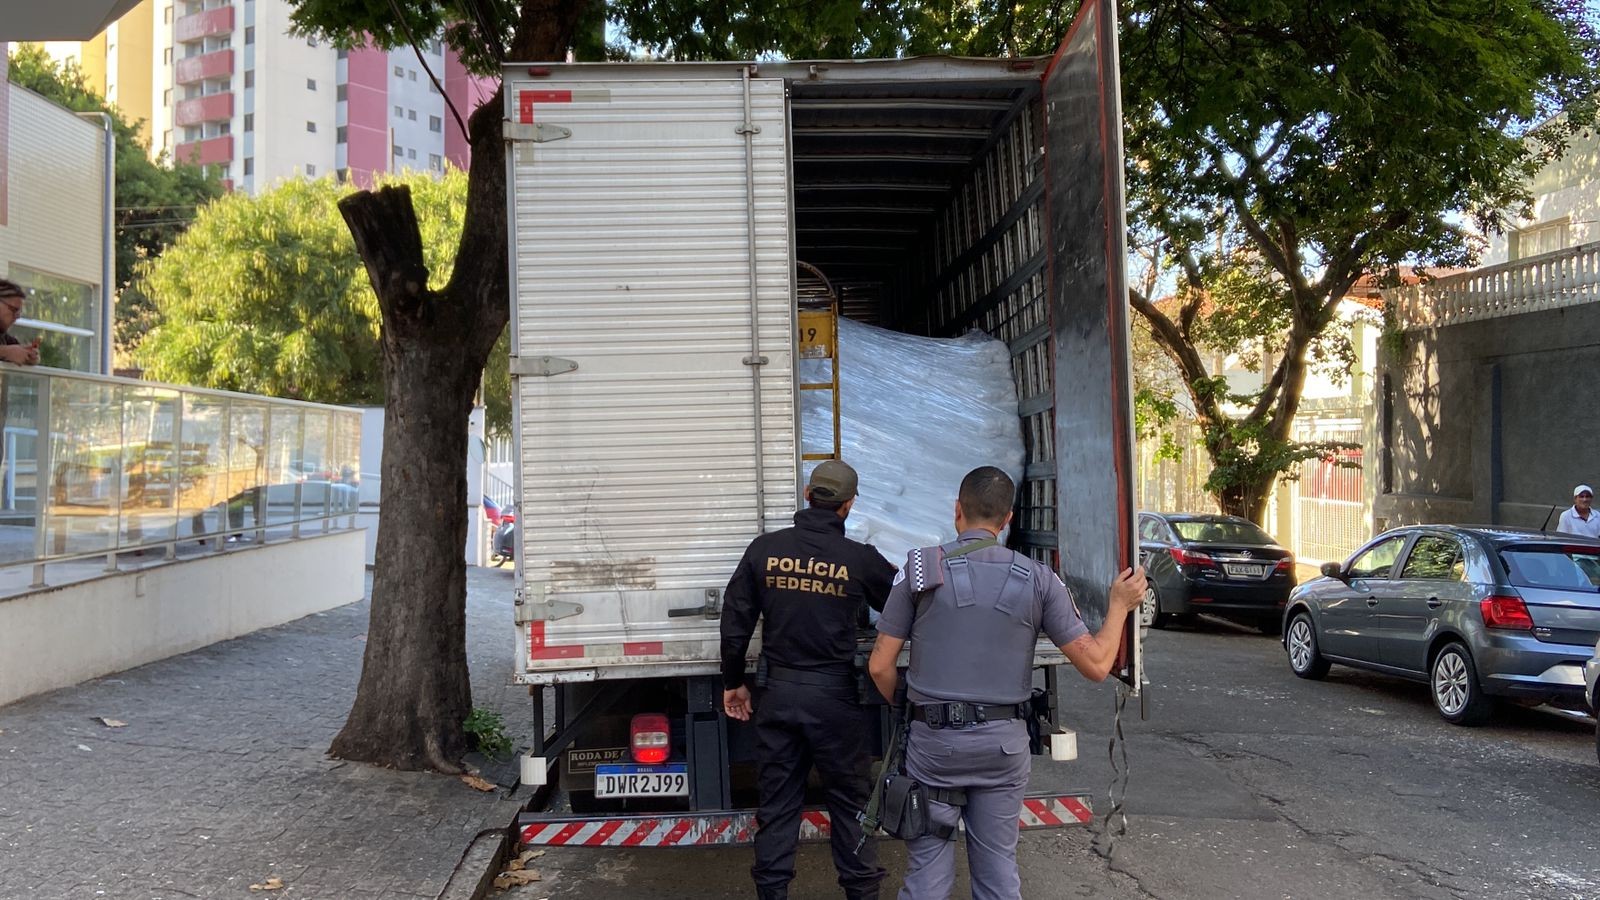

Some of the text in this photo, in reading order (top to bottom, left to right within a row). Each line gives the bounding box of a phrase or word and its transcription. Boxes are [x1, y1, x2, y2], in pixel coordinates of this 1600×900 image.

[766, 557, 849, 580] POLÍCIA
[765, 576, 847, 597] FEDERAL
[571, 751, 602, 761] RODA
[604, 750, 620, 760] DE
[606, 775, 684, 794] DWR2J99
